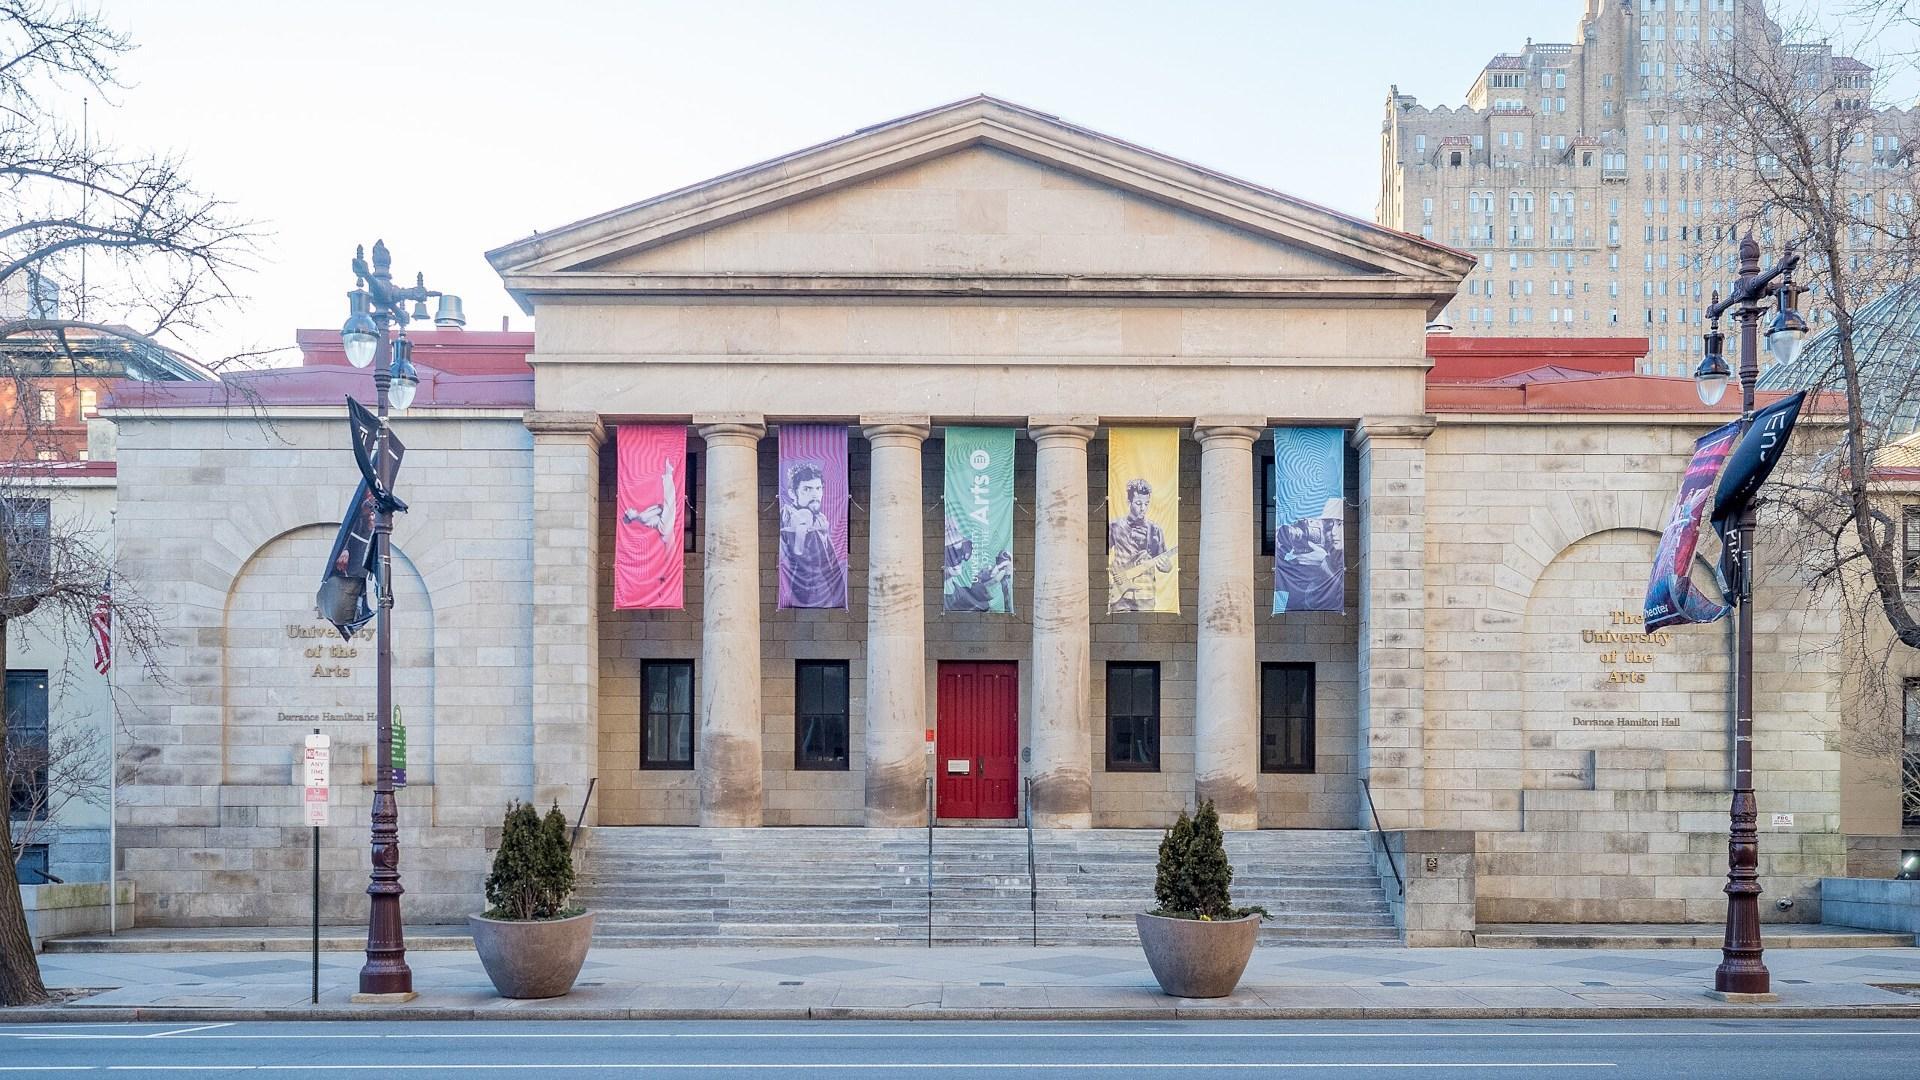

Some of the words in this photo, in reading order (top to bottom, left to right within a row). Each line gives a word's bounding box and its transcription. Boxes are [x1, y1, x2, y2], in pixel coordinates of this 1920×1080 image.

[969, 474, 990, 525] Arts
[981, 528, 990, 547] THE
[971, 529, 979, 583] UNIVERSITY
[981, 552, 990, 564] OF
[1609, 610, 1643, 625] The
[1582, 630, 1672, 646] University
[304, 645, 323, 658] of
[330, 644, 358, 658] the
[1599, 650, 1617, 663] of
[1625, 650, 1653, 663] the
[311, 663, 351, 678] Arts
[1607, 671, 1646, 684] Arts
[278, 712, 320, 721] Dorrance
[322, 712, 364, 721] Hamilton
[1572, 717, 1615, 727] Dorrance
[1617, 717, 1659, 727] Hamilton
[1661, 717, 1681, 727] Hall
